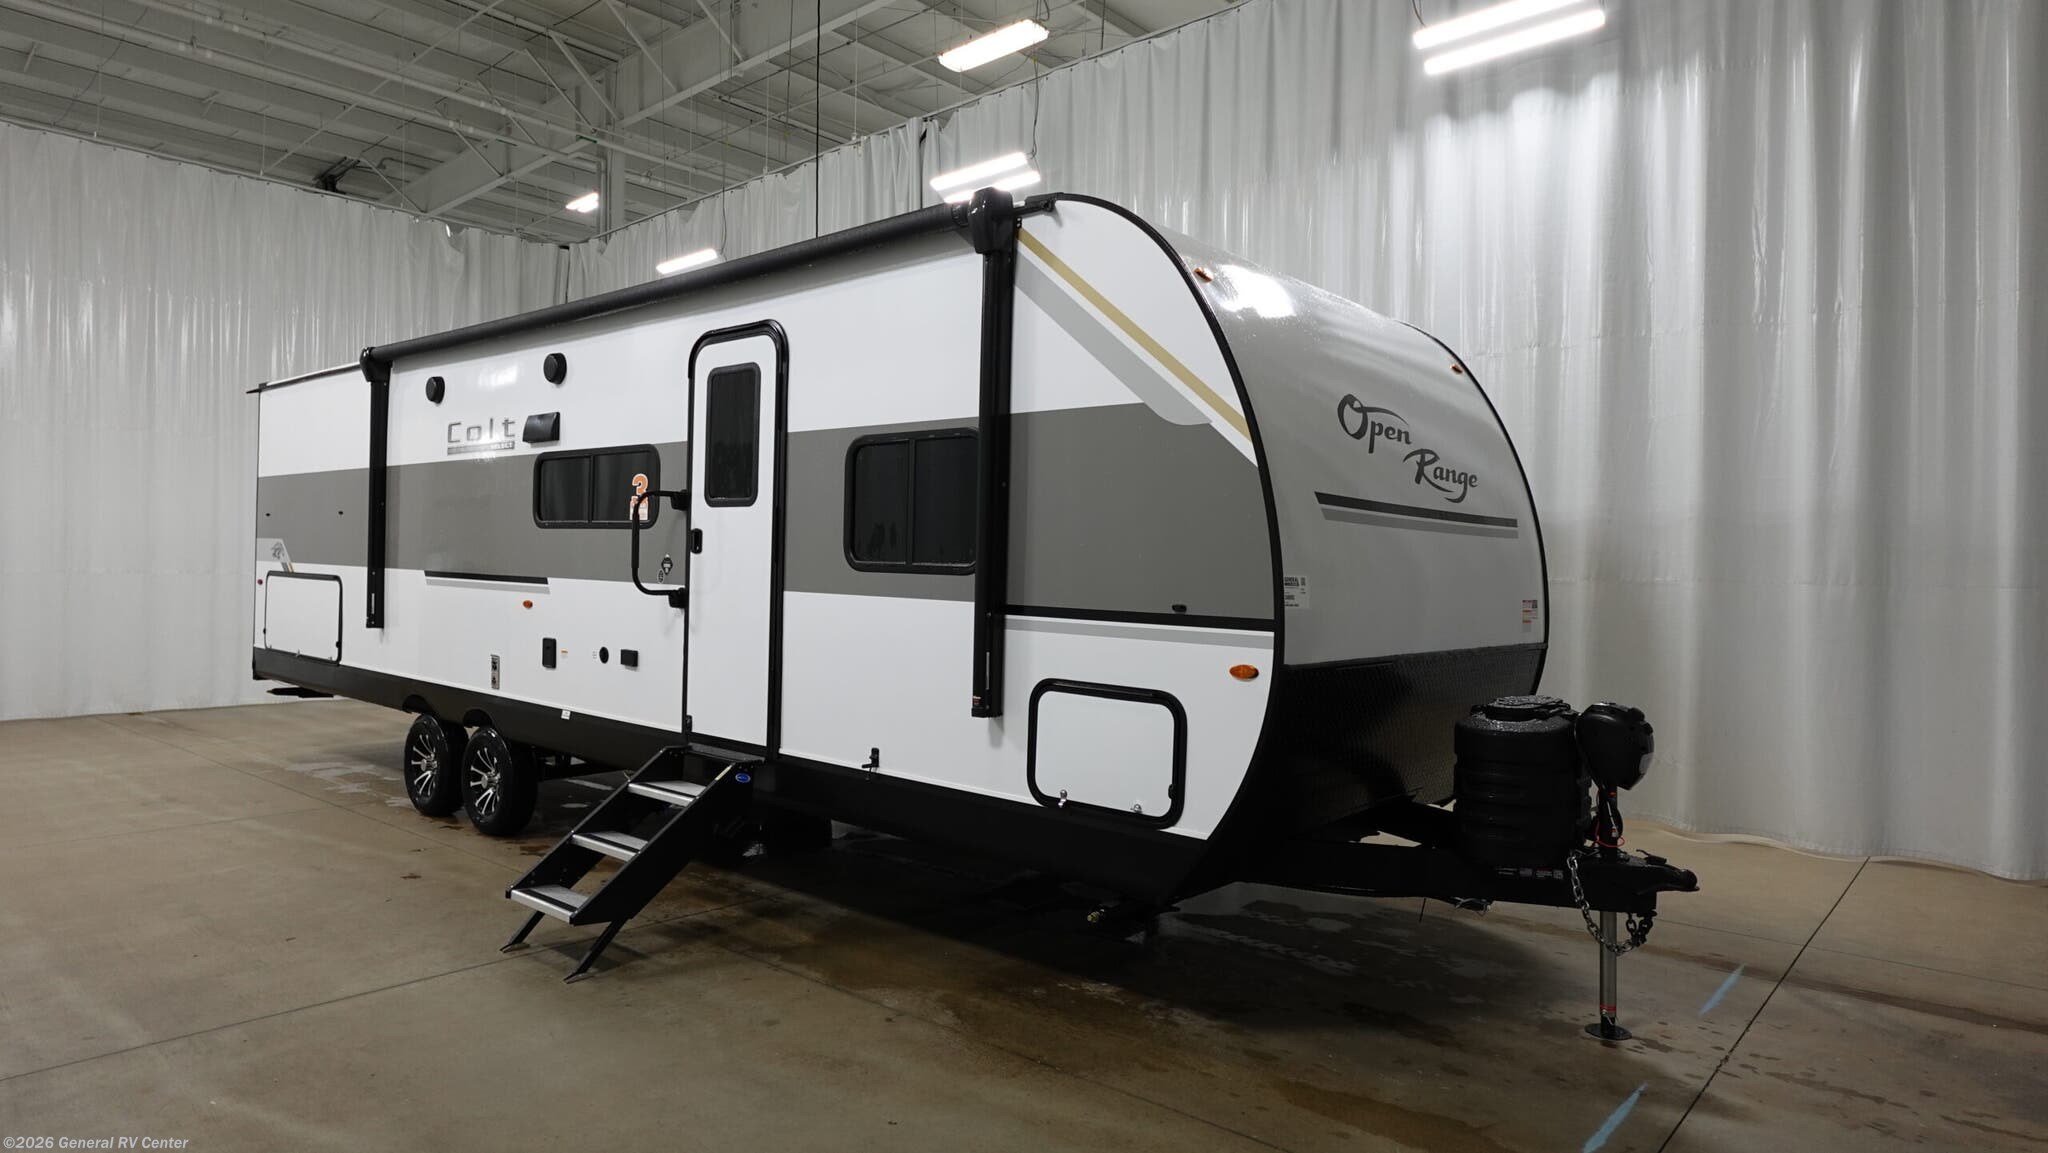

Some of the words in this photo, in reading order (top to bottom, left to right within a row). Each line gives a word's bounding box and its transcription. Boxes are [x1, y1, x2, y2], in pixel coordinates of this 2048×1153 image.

[447, 418, 516, 443] Colt
[1337, 393, 1412, 454] Open
[1402, 448, 1479, 504] Range
